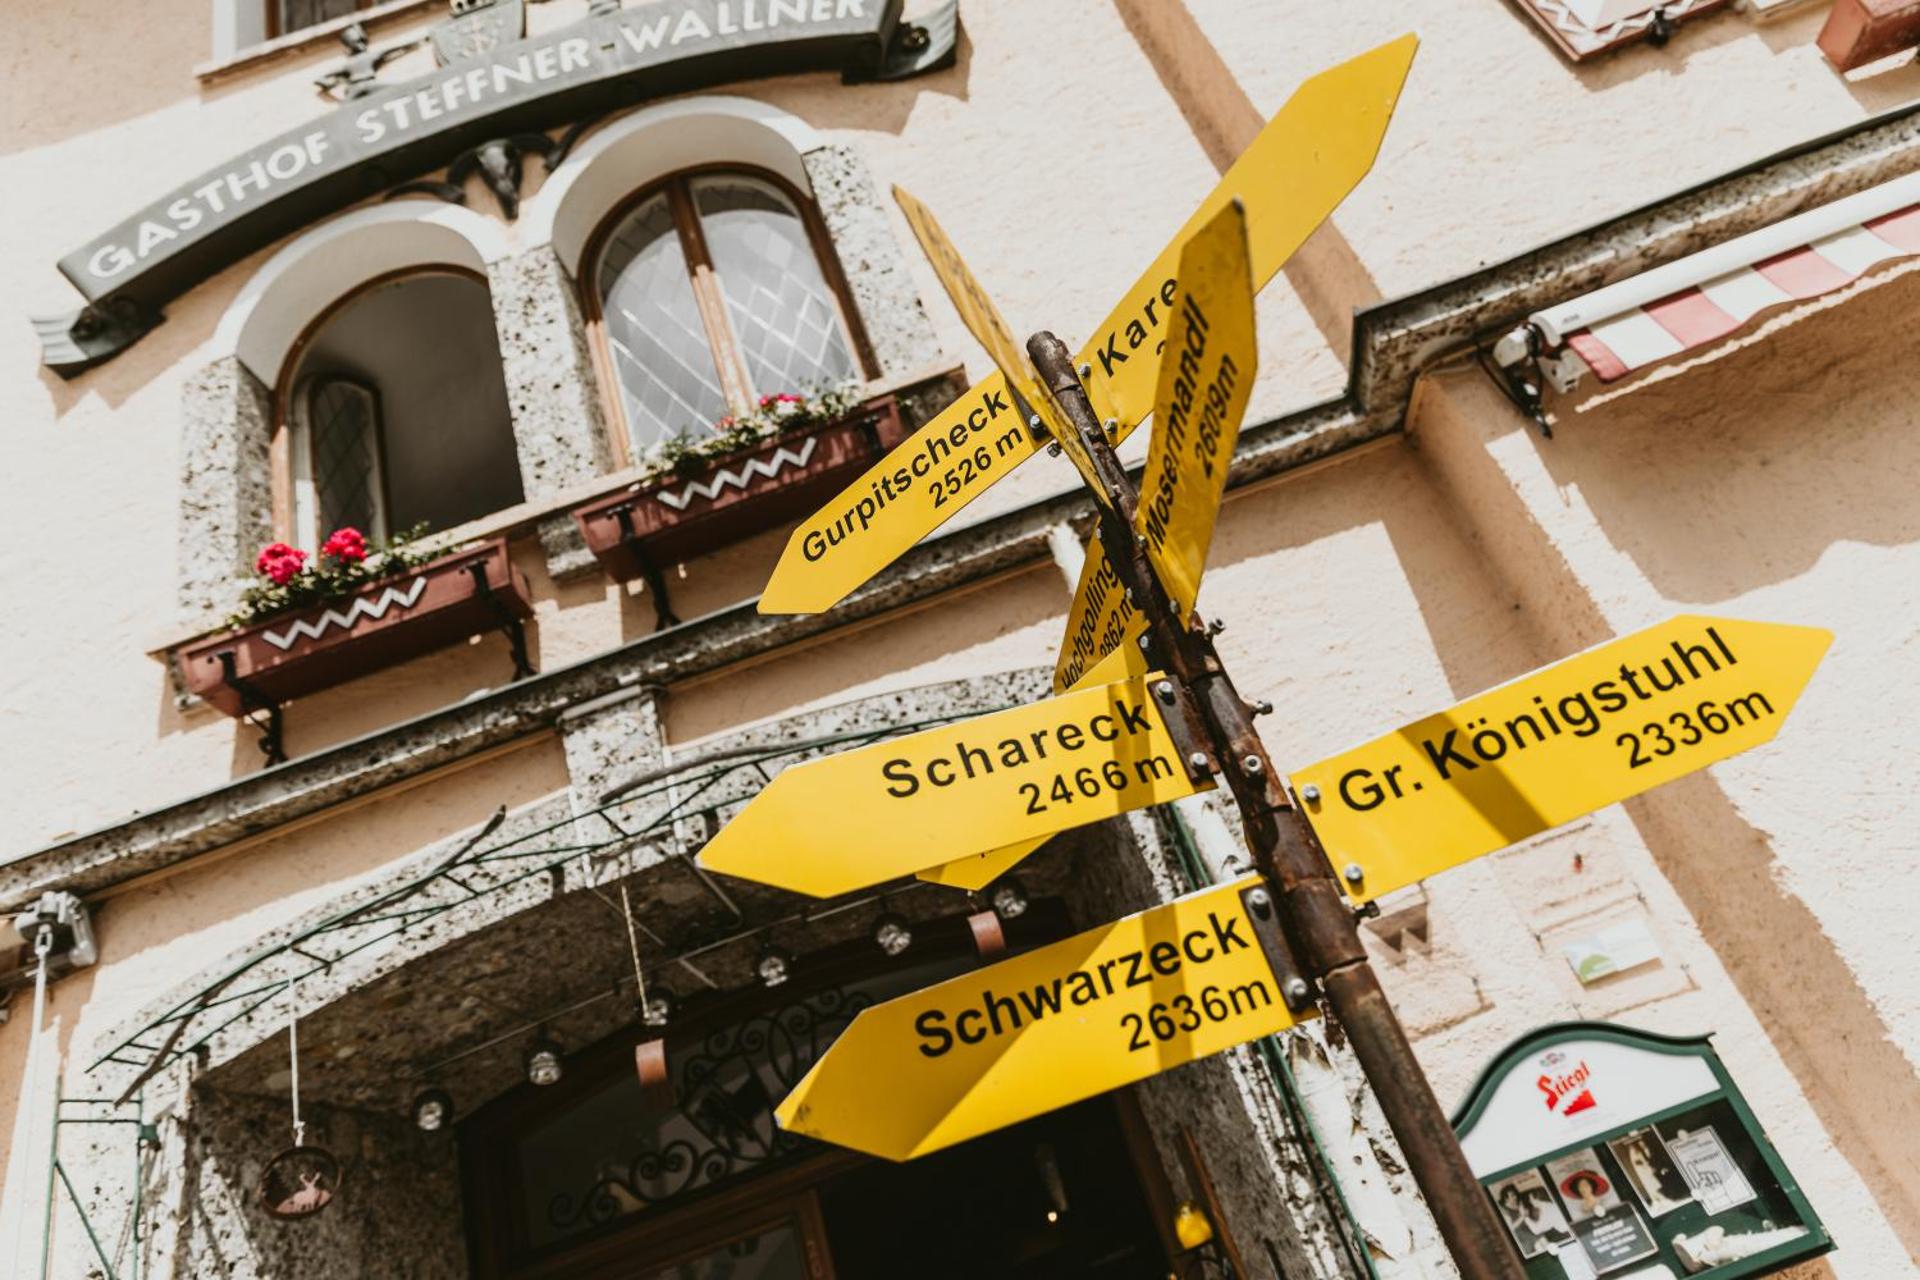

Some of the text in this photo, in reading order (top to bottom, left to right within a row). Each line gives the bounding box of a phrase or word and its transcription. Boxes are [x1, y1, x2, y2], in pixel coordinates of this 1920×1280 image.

[88, 130, 329, 278] GASTHOF
[1096, 278, 1178, 378] Kare
[929, 445, 992, 509] 2526
[995, 427, 1024, 457] m
[1146, 292, 1210, 556] Mosermandl
[1195, 352, 1239, 480] 2609m
[802, 389, 1009, 563] Gurpitscheck
[881, 699, 1153, 799] Schareck
[1338, 626, 1739, 812] Gr. Königstuhl
[1615, 691, 1776, 770] 2336m
[1018, 754, 1175, 816] 2466 m
[914, 911, 1251, 1059] Schwarzeck
[1119, 979, 1273, 1053] 2636m
